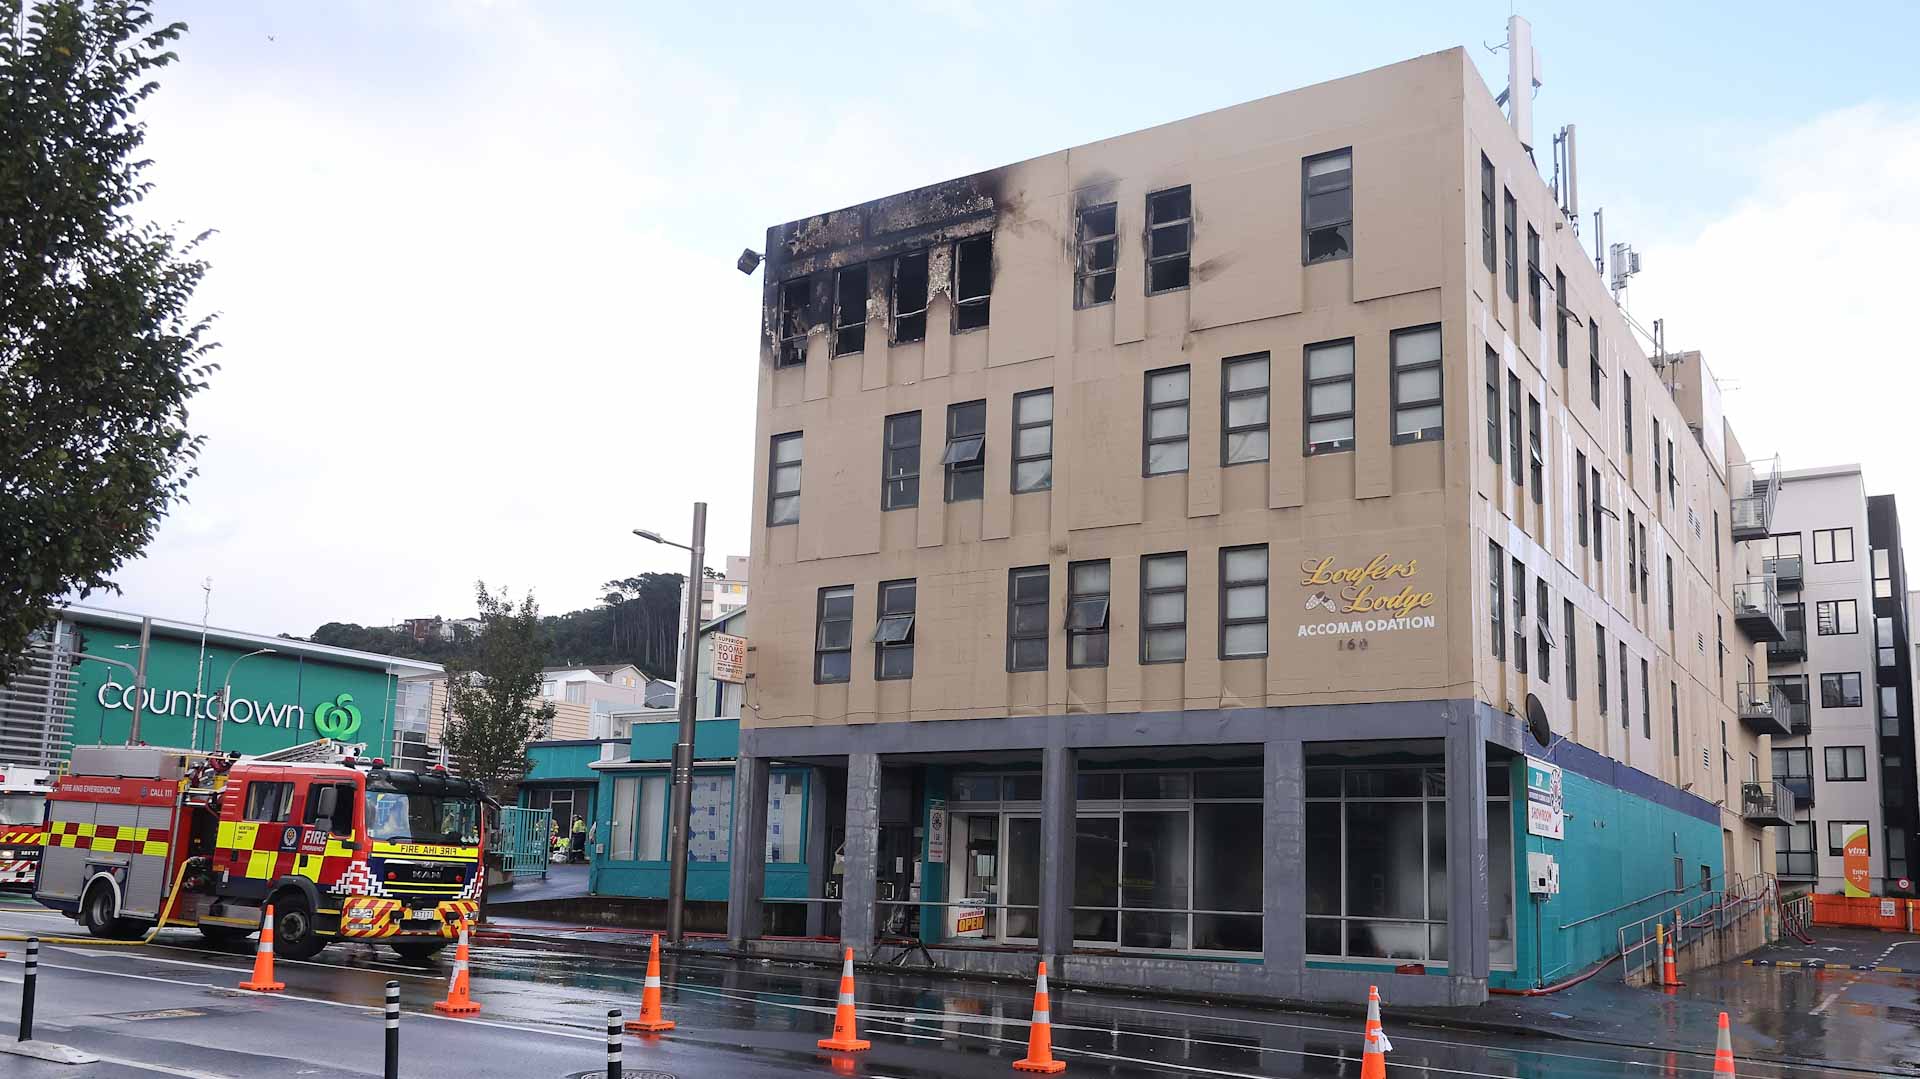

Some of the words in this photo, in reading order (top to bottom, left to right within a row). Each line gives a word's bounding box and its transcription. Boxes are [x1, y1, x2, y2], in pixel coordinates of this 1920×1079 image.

[1301, 554, 1418, 586] Loafers
[1340, 585, 1434, 618] Lodge
[1298, 616, 1436, 637] ACCOMMODATION
[718, 644, 743, 655] ROOMS
[1338, 639, 1369, 651] 160
[718, 652, 729, 661] TO
[731, 655, 743, 663] LET
[97, 681, 304, 730] countdown
[150, 788, 163, 797] CALL
[164, 789, 173, 797] 111
[303, 830, 327, 845] FIRE
[400, 844, 419, 853] FIRE
[423, 846, 437, 854] AHI
[1848, 846, 1867, 855] vtnz
[412, 870, 441, 879] MAN
[1852, 868, 1868, 877] Entry
[959, 917, 984, 932] OPEN
